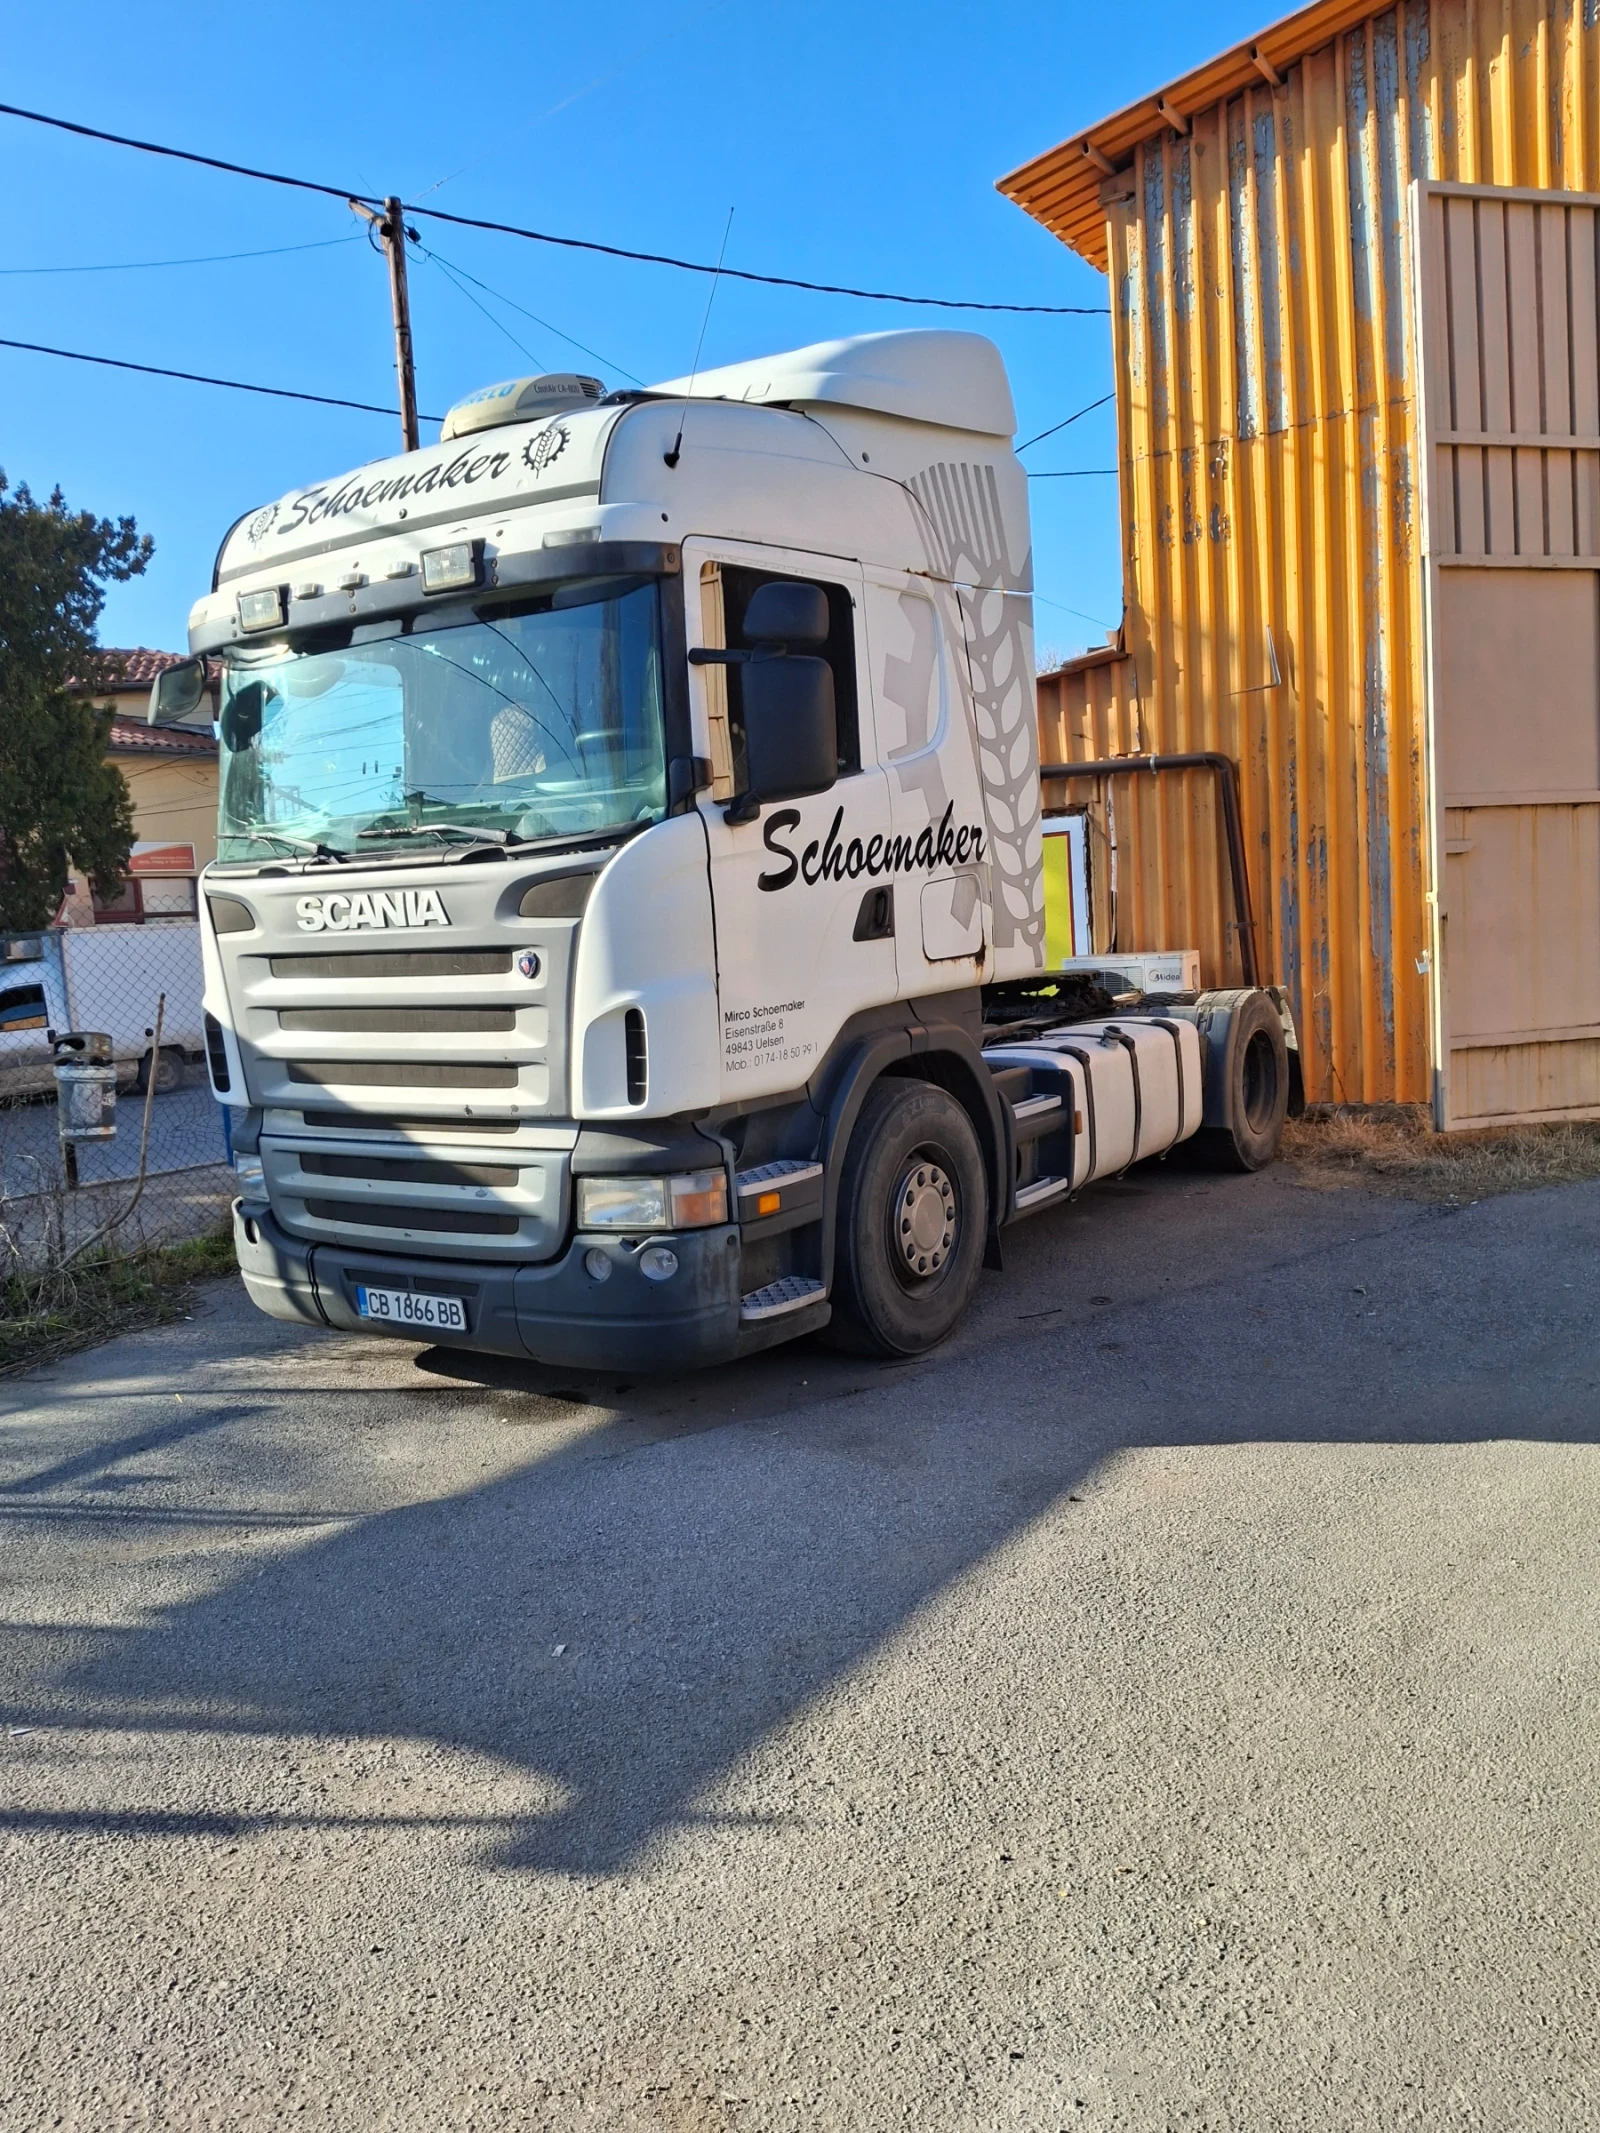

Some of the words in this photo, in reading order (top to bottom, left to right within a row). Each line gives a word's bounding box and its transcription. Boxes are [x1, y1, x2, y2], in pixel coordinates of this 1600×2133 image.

[276, 443, 511, 536] Schoemaker
[757, 799, 987, 892] Schoemaker
[296, 890, 452, 932] SCANIA
[1154, 972, 1181, 982] Midea
[724, 1010, 751, 1023] Mirco
[752, 999, 806, 1018] Schoemaker
[725, 1020, 777, 1039] Eisenstraße
[778, 1018, 784, 1029] 8
[725, 1040, 754, 1055] 49843
[755, 1036, 785, 1050] Uelsen
[725, 1059, 752, 1072] Mob.:
[754, 1048, 789, 1067] 0174-18
[790, 1046, 800, 1059] 50
[368, 1292, 390, 1316] CB
[394, 1295, 434, 1322] 1866
[437, 1301, 461, 1325] BB
